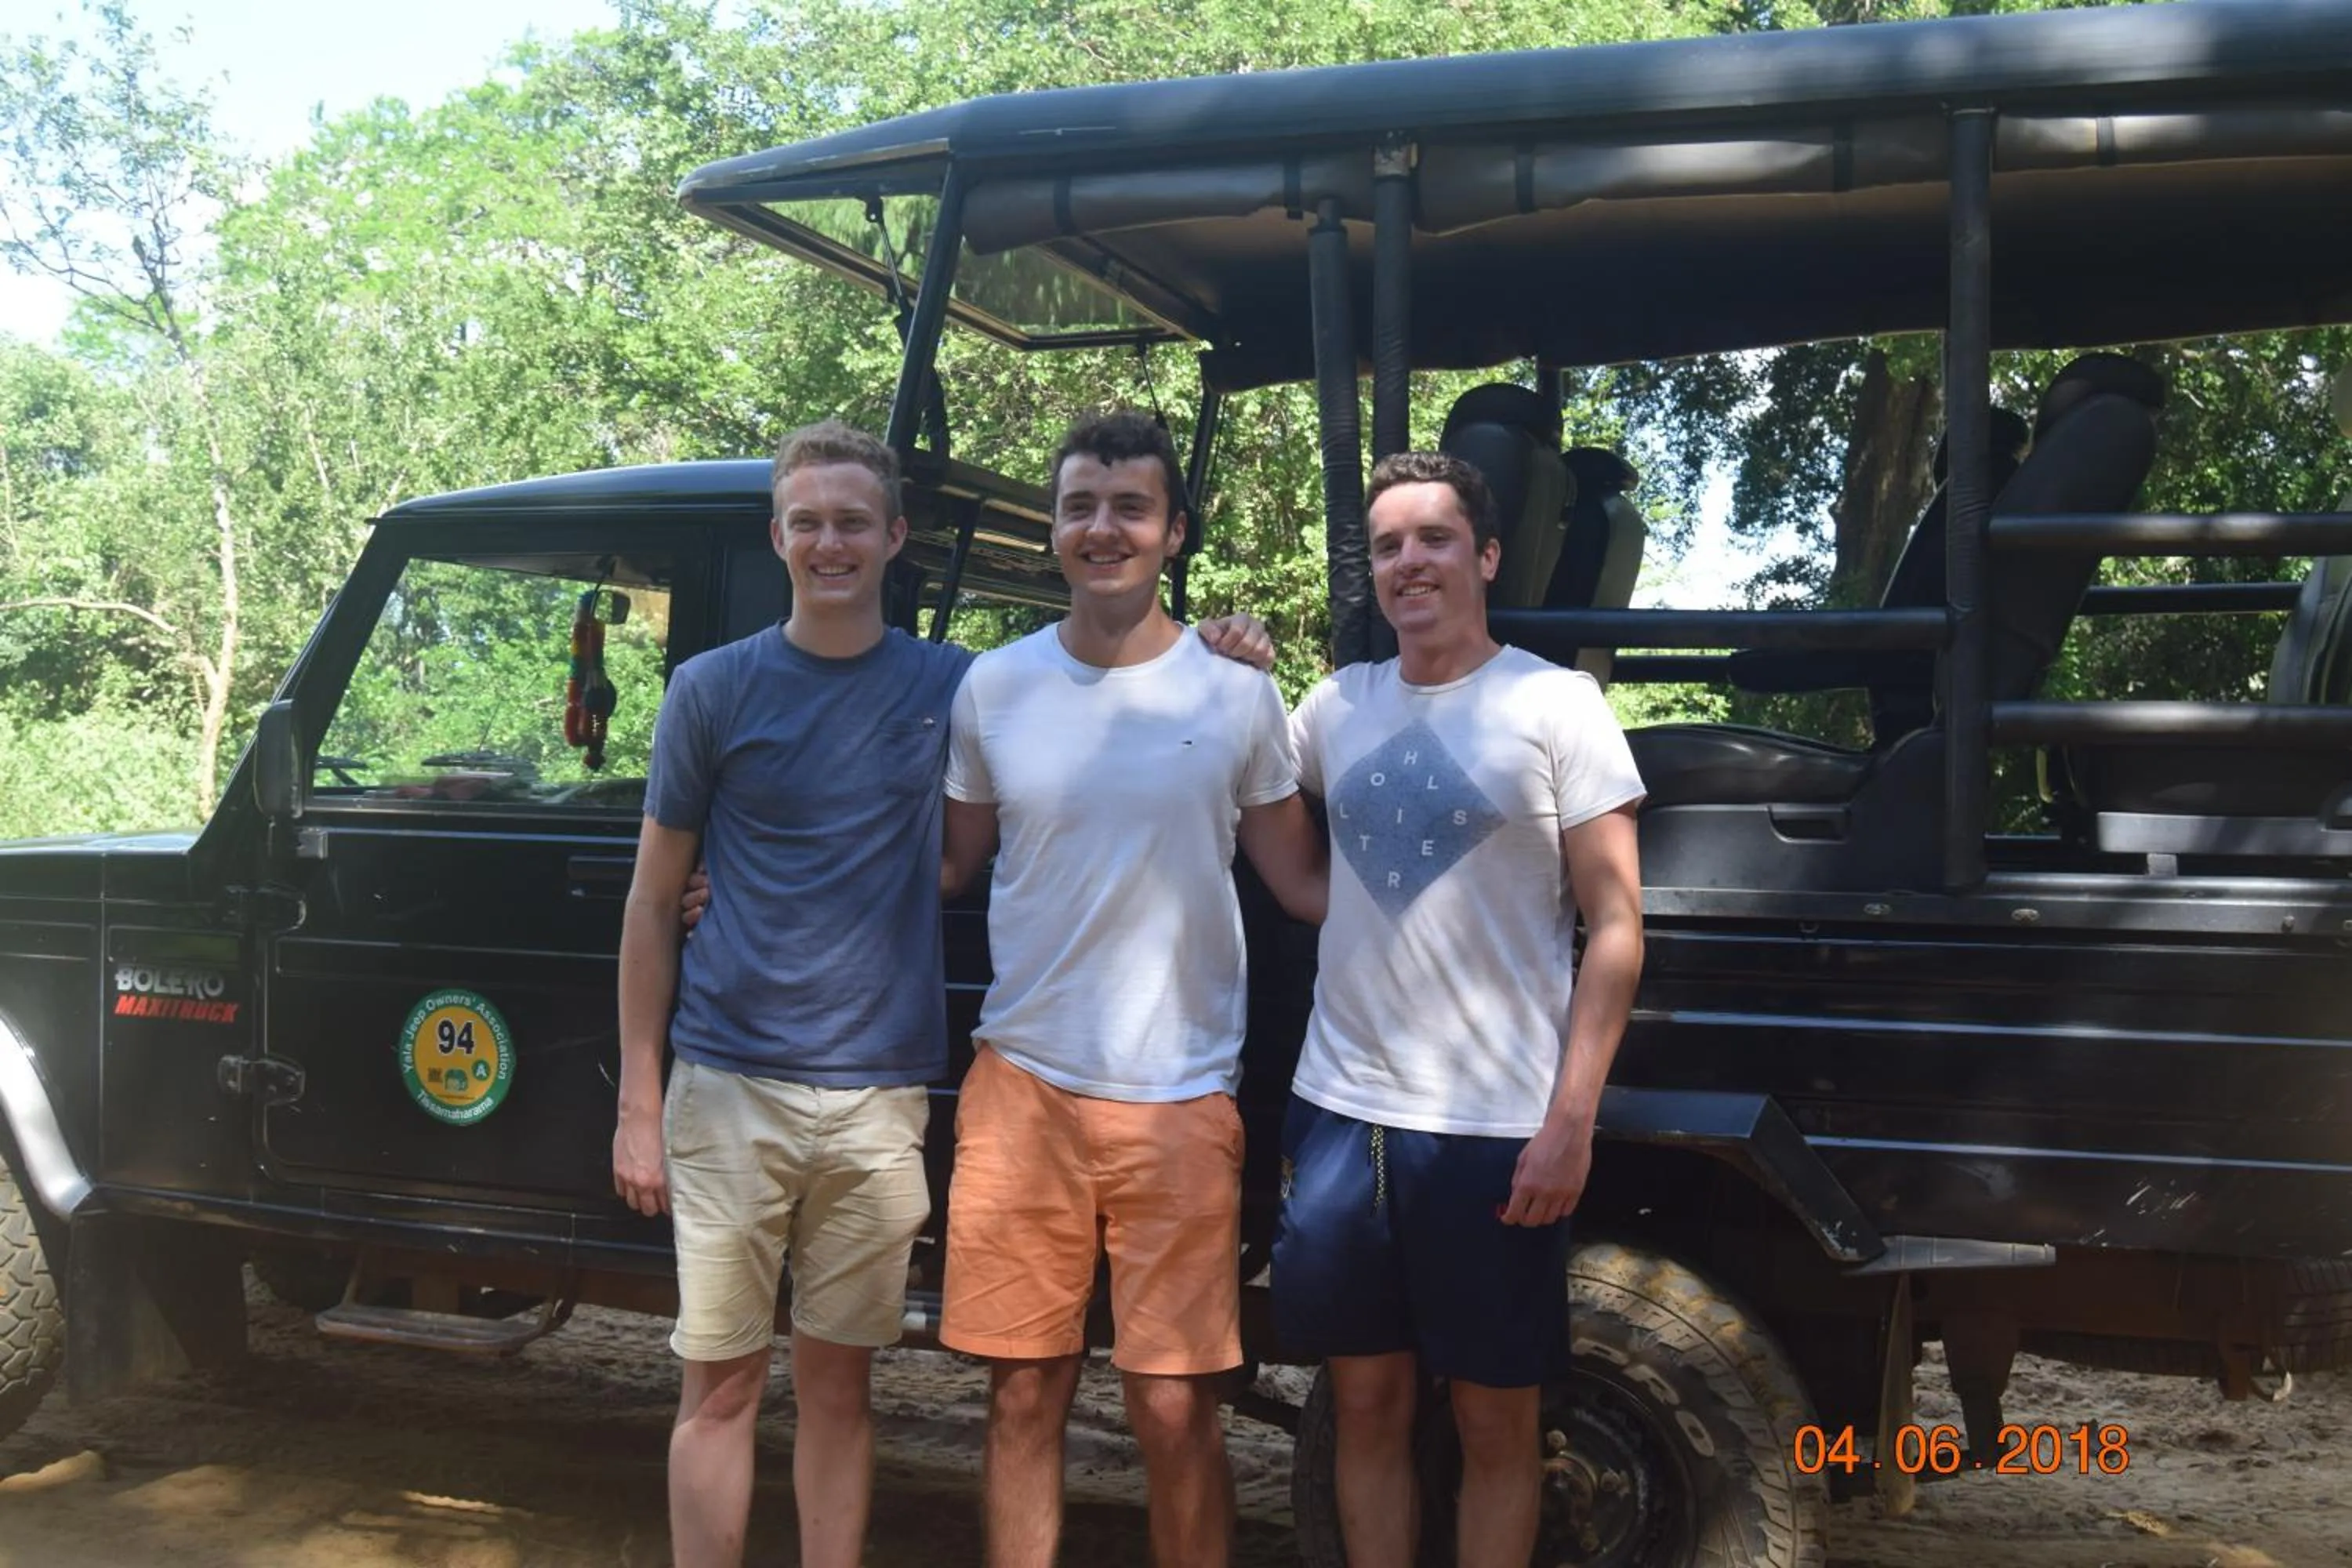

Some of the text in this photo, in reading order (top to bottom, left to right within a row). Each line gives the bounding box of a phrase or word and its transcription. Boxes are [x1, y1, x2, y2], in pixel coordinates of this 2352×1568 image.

[114, 967, 225, 1000] BOLERO
[114, 993, 240, 1024] MAXITRUCK
[405, 1010, 426, 1040] Jeep
[476, 1004, 510, 1080] Association
[437, 1019, 474, 1054] 94
[475, 1064, 487, 1078] A
